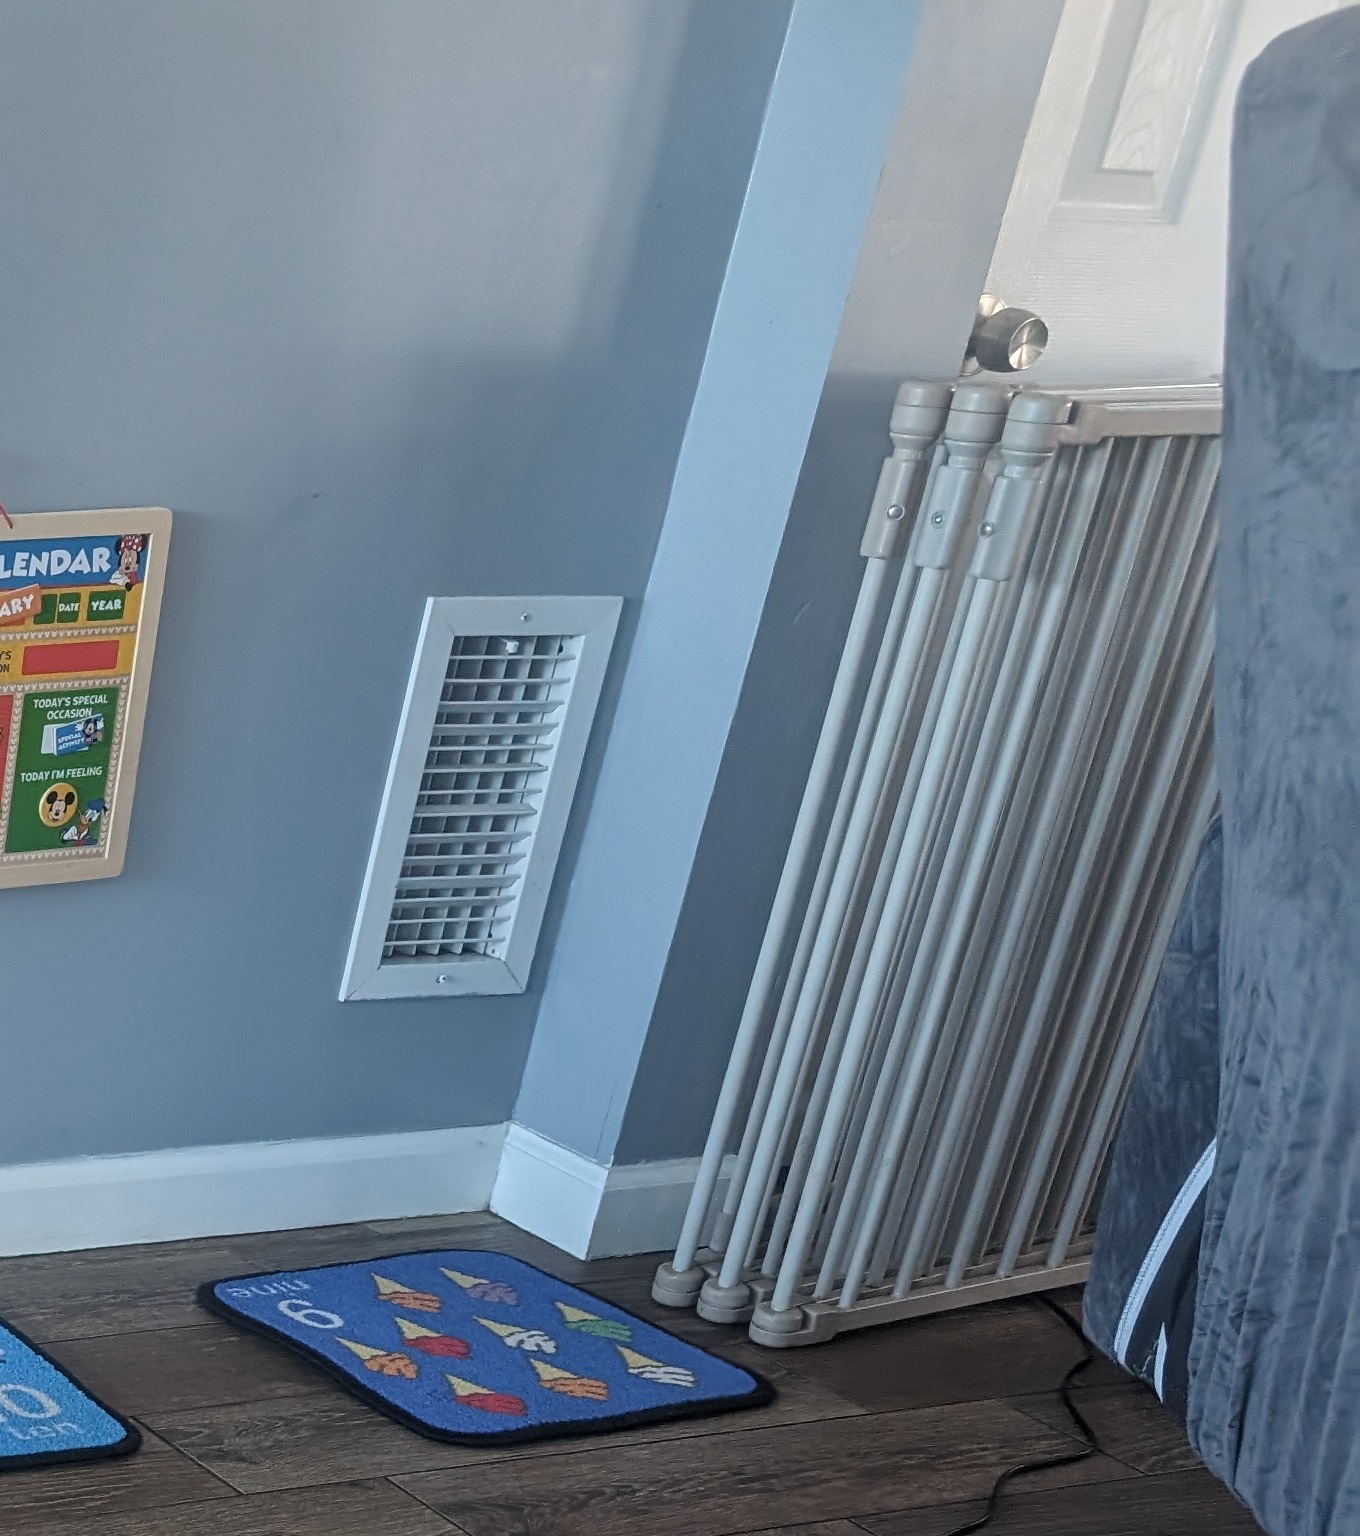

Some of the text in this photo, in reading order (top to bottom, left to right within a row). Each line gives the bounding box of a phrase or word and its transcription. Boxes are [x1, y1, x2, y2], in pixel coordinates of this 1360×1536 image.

[58, 603, 80, 612] DATE
[91, 599, 122, 611] YEAR
[33, 694, 108, 709] TODAY'S SPECIAL
[47, 708, 92, 720] OCCASION
[21, 766, 103, 783] TODAY I'M FEELING
[226, 1280, 309, 1297] nine
[8, 1422, 85, 1440] ten
